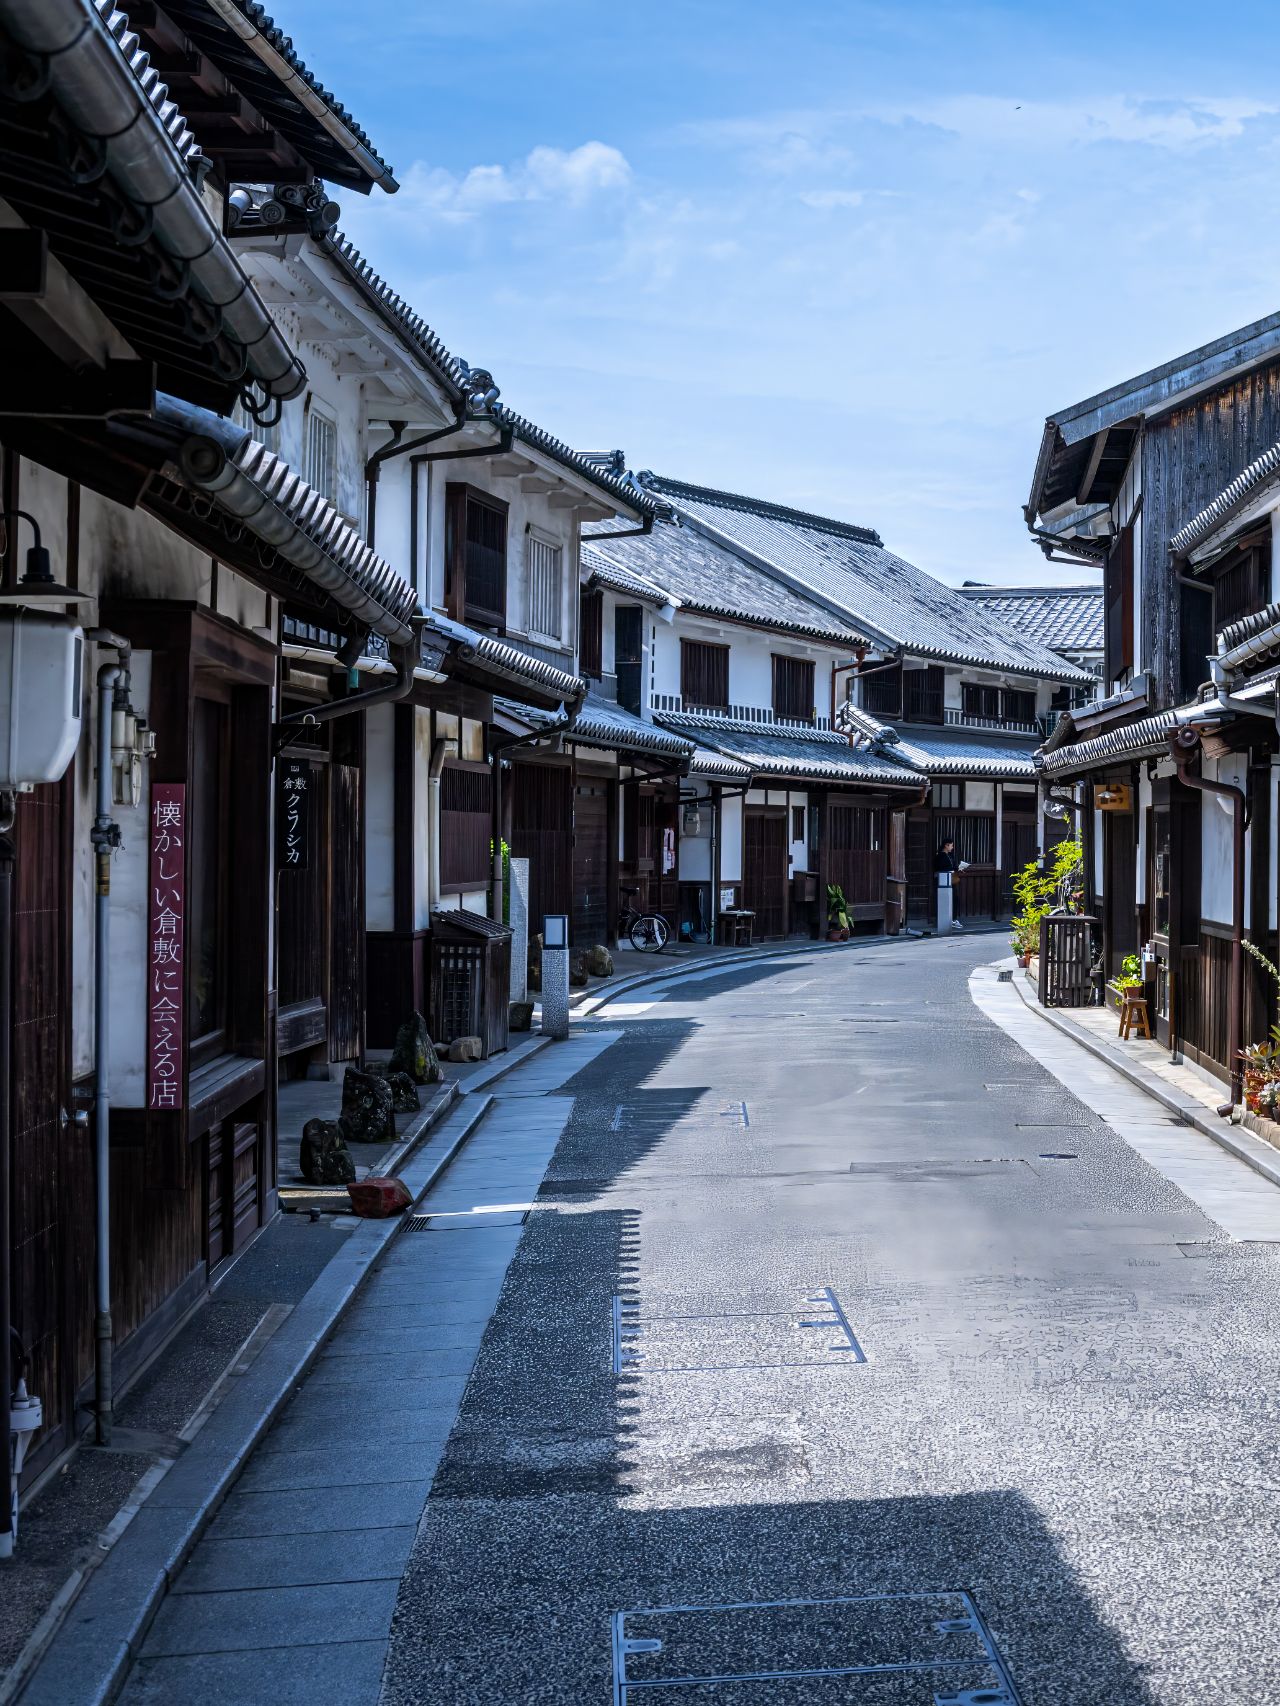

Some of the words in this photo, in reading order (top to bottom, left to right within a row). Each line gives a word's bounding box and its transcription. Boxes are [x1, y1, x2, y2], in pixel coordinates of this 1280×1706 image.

[283, 777, 307, 790] 倉敷
[286, 793, 301, 864] クラシカ
[152, 801, 182, 1106] 懐かしい倉敷に会える店
